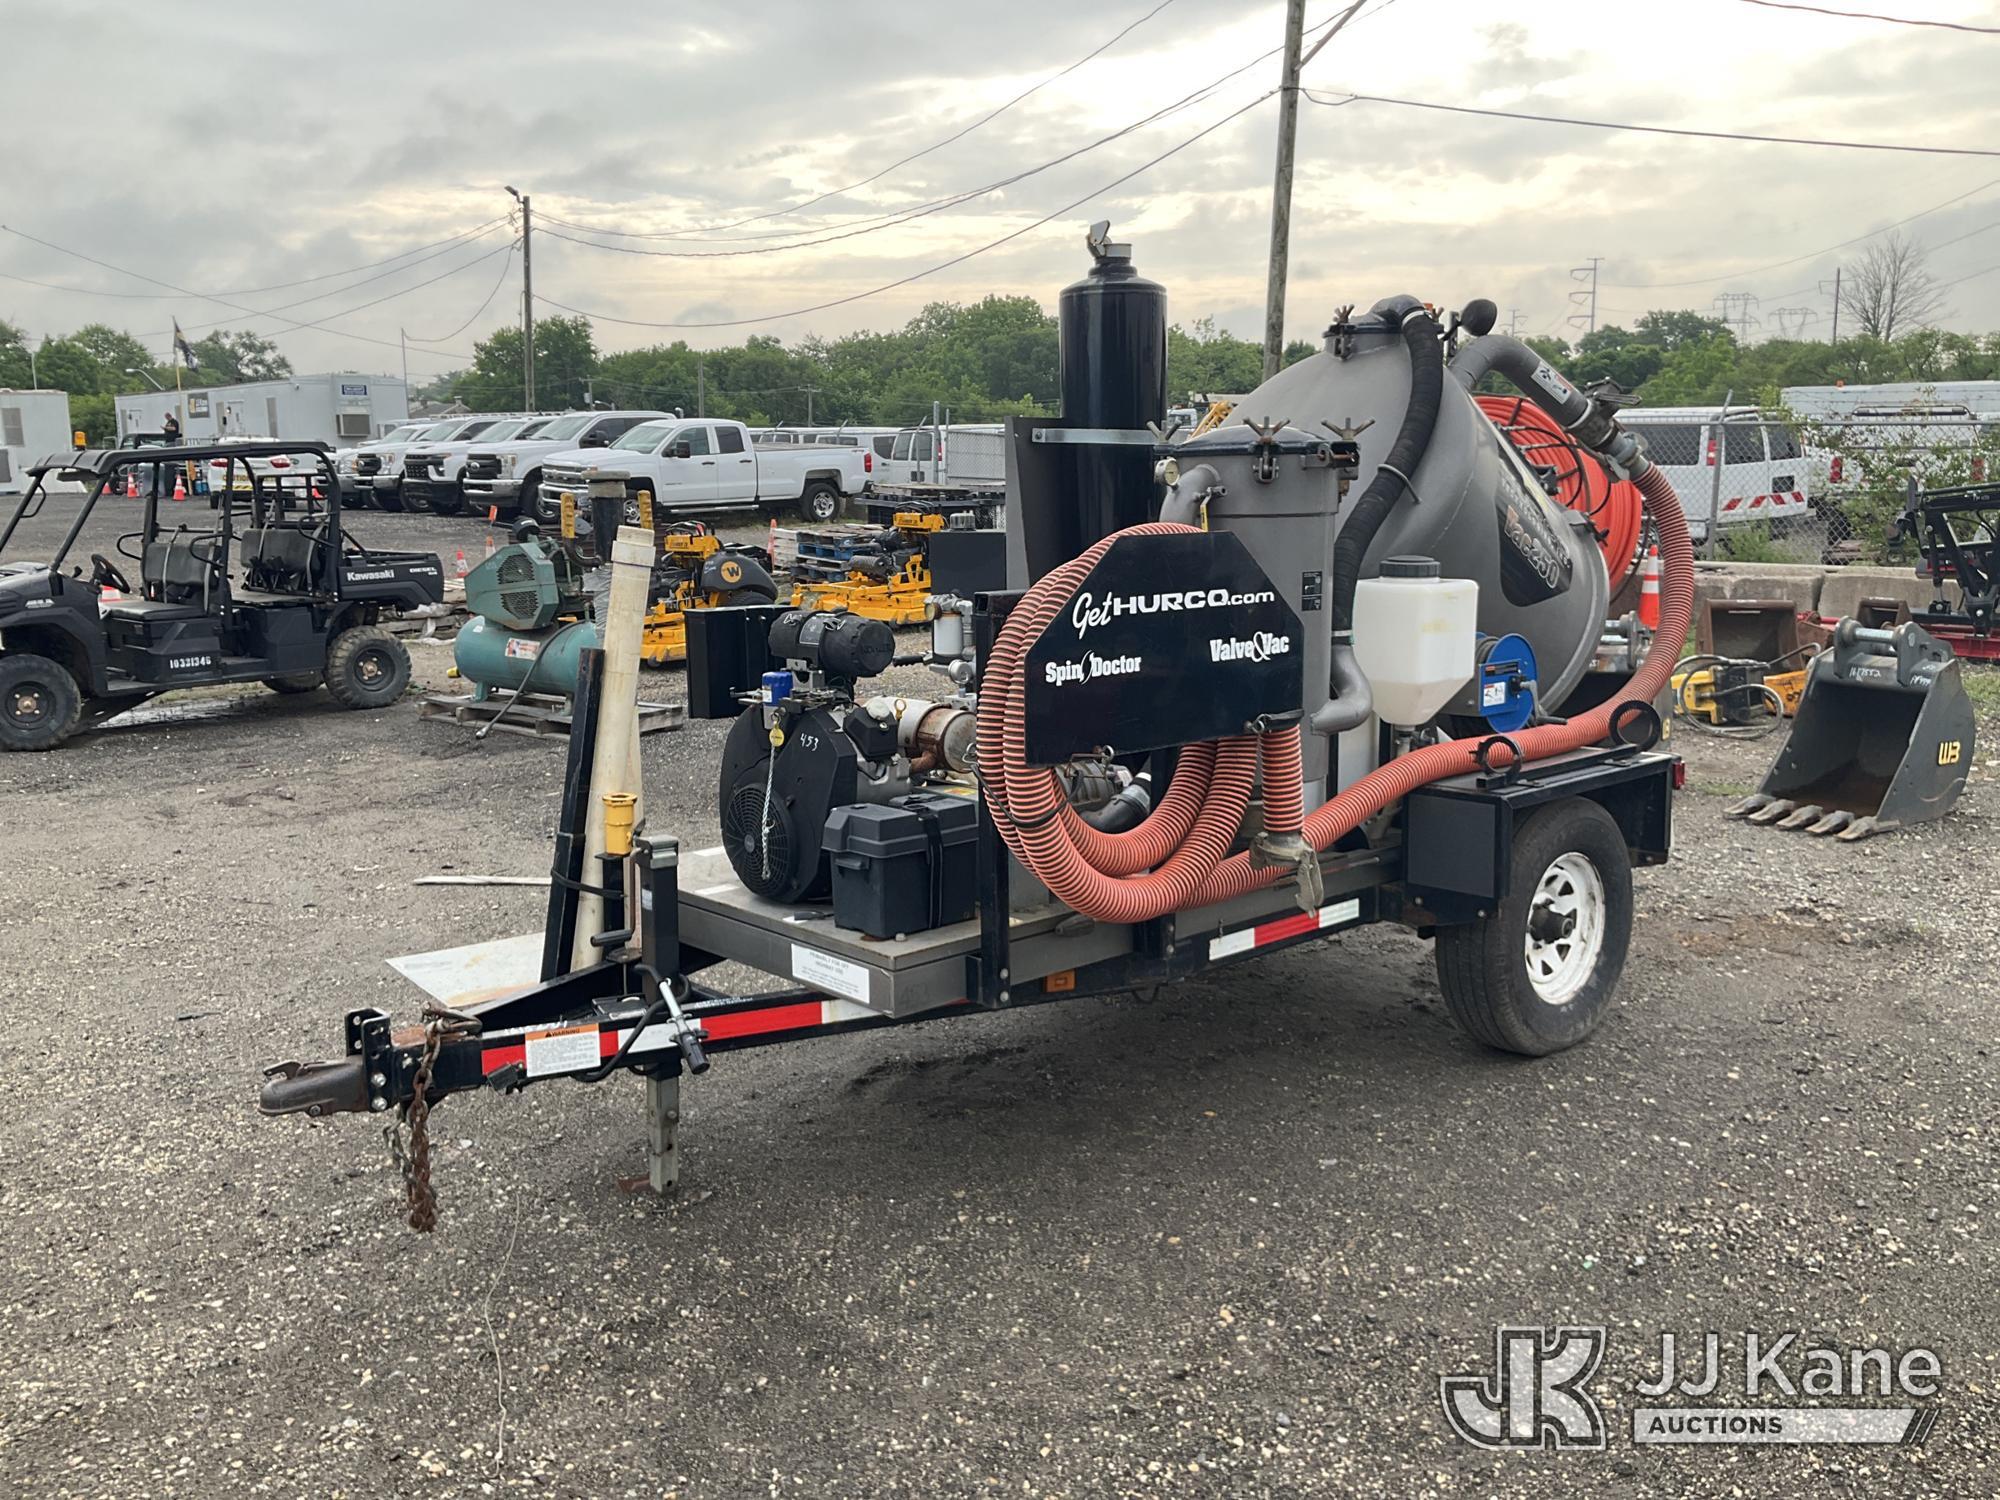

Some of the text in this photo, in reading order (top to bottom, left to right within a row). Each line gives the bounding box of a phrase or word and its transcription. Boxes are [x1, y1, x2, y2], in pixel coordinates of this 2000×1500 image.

[347, 569, 395, 581] Kawasaki
[801, 732, 819, 751] 453
[1937, 741, 1961, 765] WB
[552, 1027, 580, 1037] WARNING
